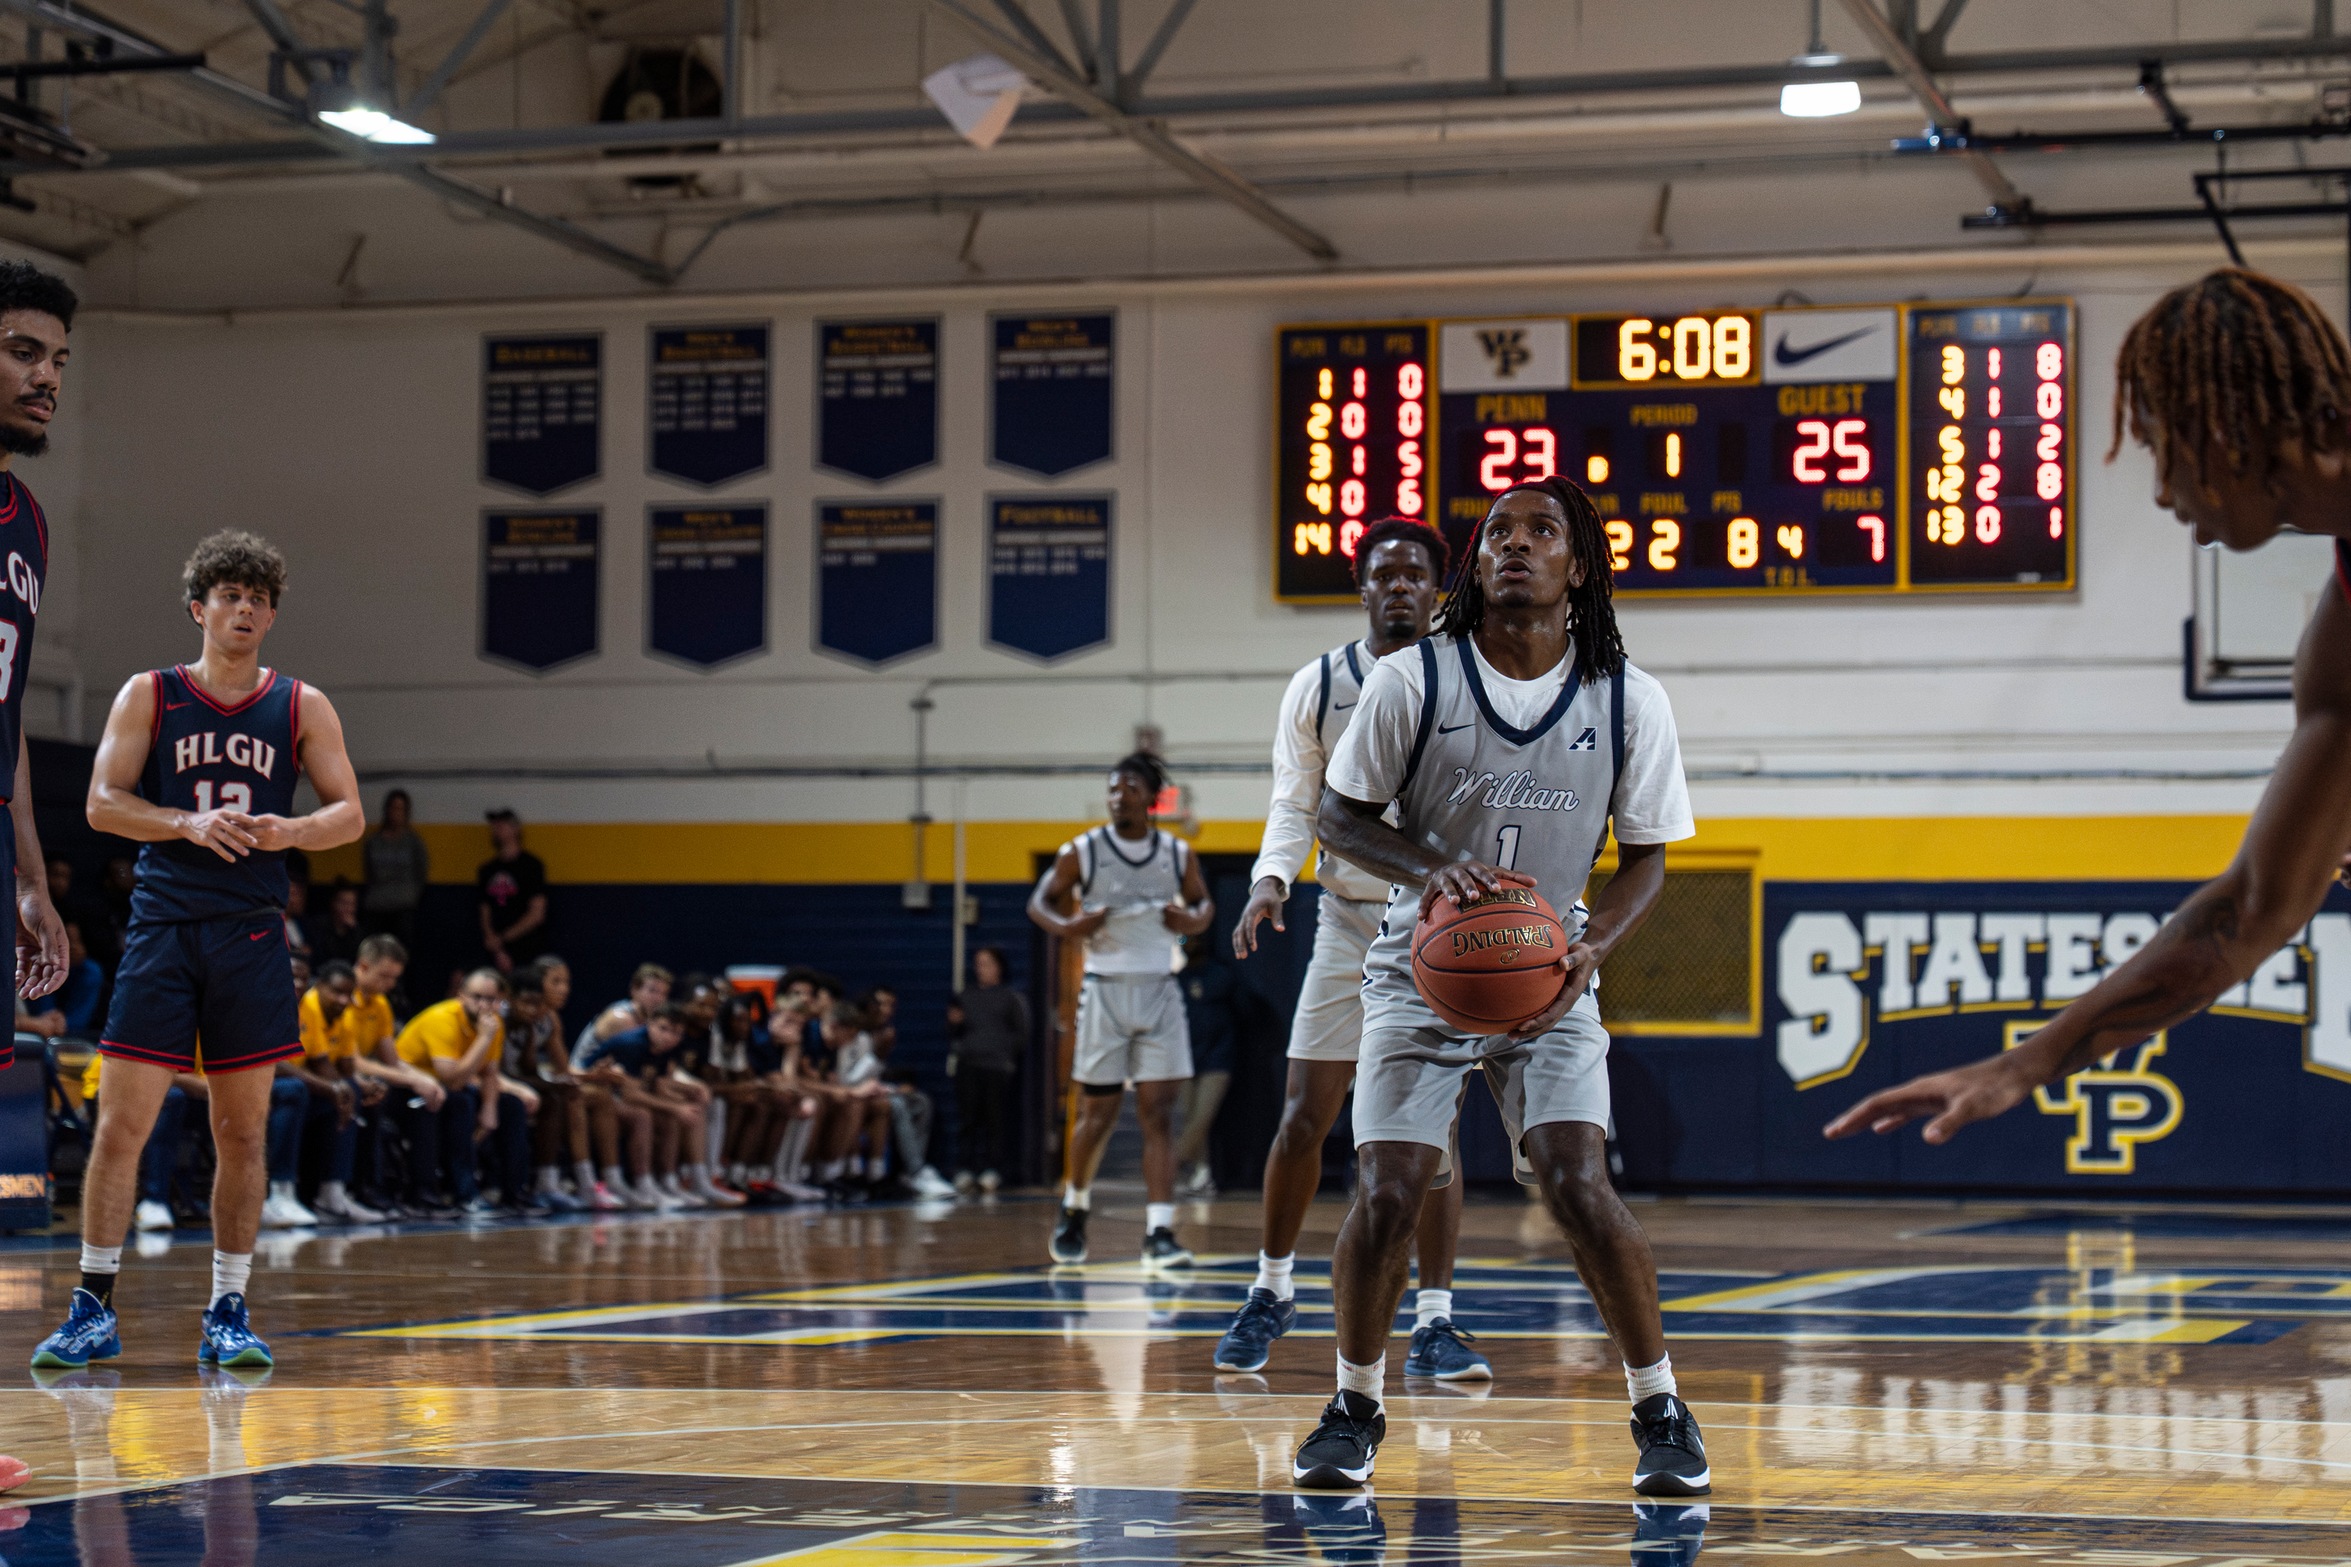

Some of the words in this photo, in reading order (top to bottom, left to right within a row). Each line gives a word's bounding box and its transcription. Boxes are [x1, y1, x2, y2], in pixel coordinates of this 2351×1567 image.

[1618, 316, 1751, 381] 6:08
[1941, 345, 1965, 385] 3
[1988, 347, 2001, 379] 1
[2036, 343, 2062, 381] 8
[1319, 368, 1332, 399] 1
[1353, 367, 1366, 398] 1
[1399, 363, 1424, 399] 0
[1778, 385, 1867, 415] GUEST
[1939, 387, 1965, 420] 4
[1988, 386, 2001, 418] 1
[2036, 382, 2062, 420] 0
[1307, 402, 1332, 440] 2
[1341, 402, 1365, 438] 0
[1399, 401, 1422, 437] 0
[1310, 442, 1332, 480] 3
[1352, 444, 1366, 476] 1
[1398, 440, 1422, 478] 5
[1480, 428, 1555, 490] 23
[1666, 433, 1680, 478] 1
[1793, 419, 1870, 482] 25
[1939, 425, 1965, 464] 5
[1988, 428, 2001, 460] 1
[2036, 423, 2062, 461] 2
[1306, 483, 1332, 515] 4
[1341, 479, 1365, 516] 0
[1398, 478, 1422, 515] 6
[1927, 464, 1965, 503] 12
[1976, 463, 2001, 501] 2
[2036, 462, 2062, 500] 8
[1295, 522, 1331, 555] 14
[1648, 518, 1680, 571] 2
[1727, 517, 1759, 569] 8
[1777, 525, 1802, 559] 4
[1857, 515, 1885, 562] 7
[1927, 505, 1965, 545] 13
[1976, 505, 2001, 544] 0
[2049, 506, 2062, 539] 1
[175, 731, 276, 781] HLGU
[1447, 766, 1580, 812] William
[1496, 825, 1522, 871] 1
[1452, 924, 1554, 957] SPALDING
[1777, 911, 2351, 1091] STATESE
